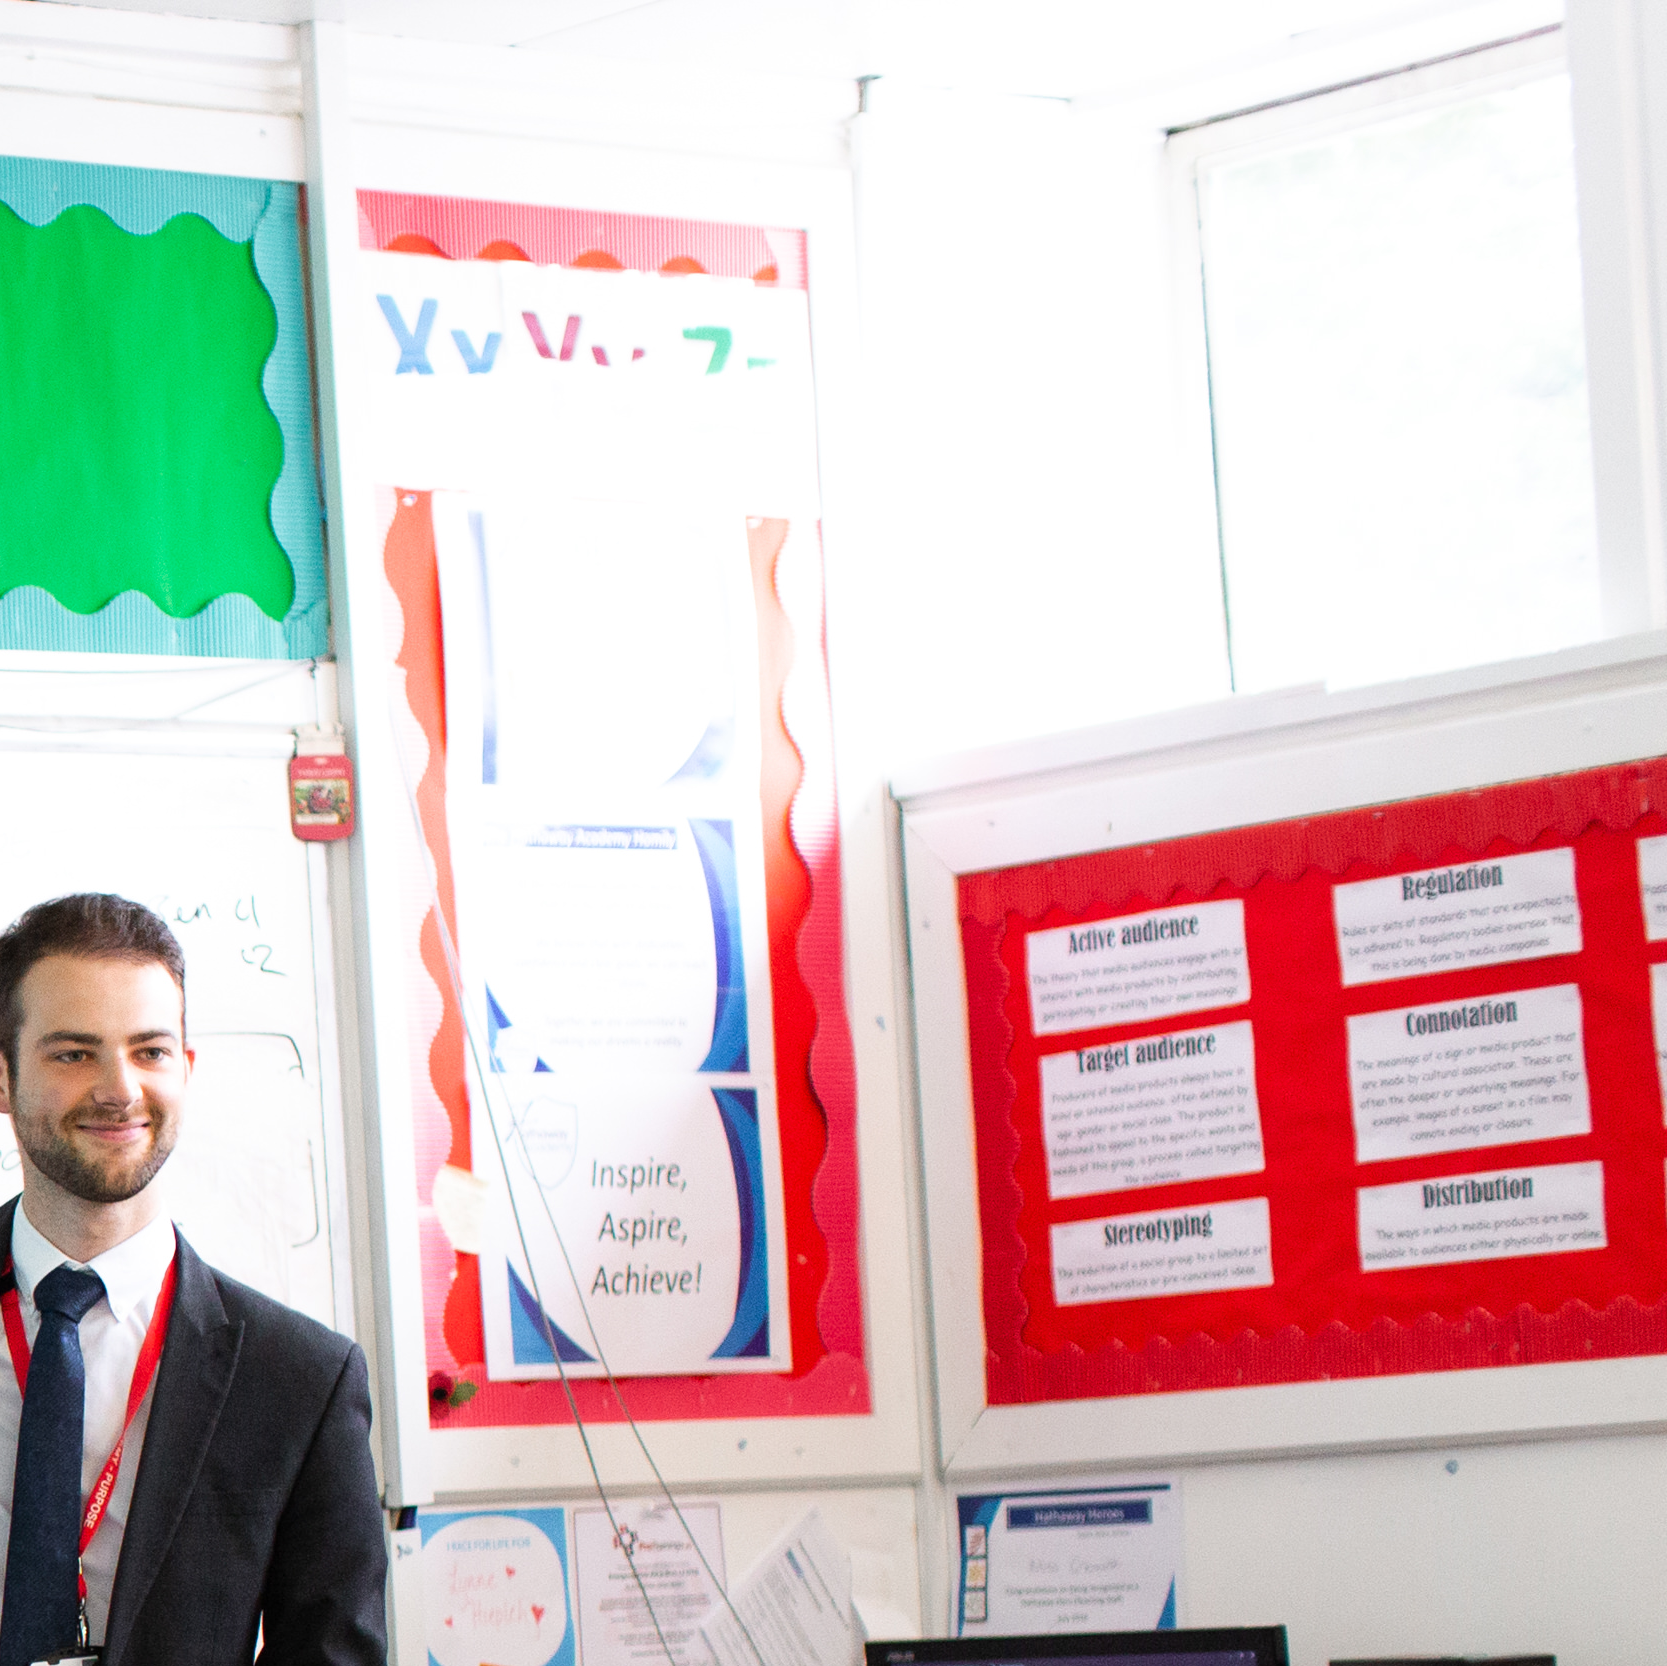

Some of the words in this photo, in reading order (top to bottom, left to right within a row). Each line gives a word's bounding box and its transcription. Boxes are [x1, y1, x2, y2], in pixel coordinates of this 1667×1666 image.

[1402, 865, 1504, 901] Regulation
[1068, 926, 1117, 955] Active
[1121, 914, 1200, 946] audience
[1406, 1000, 1518, 1037] Connotation
[1076, 1044, 1130, 1074] Target
[1136, 1032, 1216, 1064] audience
[592, 1156, 687, 1195] Inspire,
[1423, 1176, 1535, 1209] Distribution
[598, 1210, 688, 1248] Aspire,
[1103, 1210, 1213, 1248] Stereotyping
[591, 1262, 702, 1295] Achieve!
[84, 1472, 114, 1529] PURPOSE
